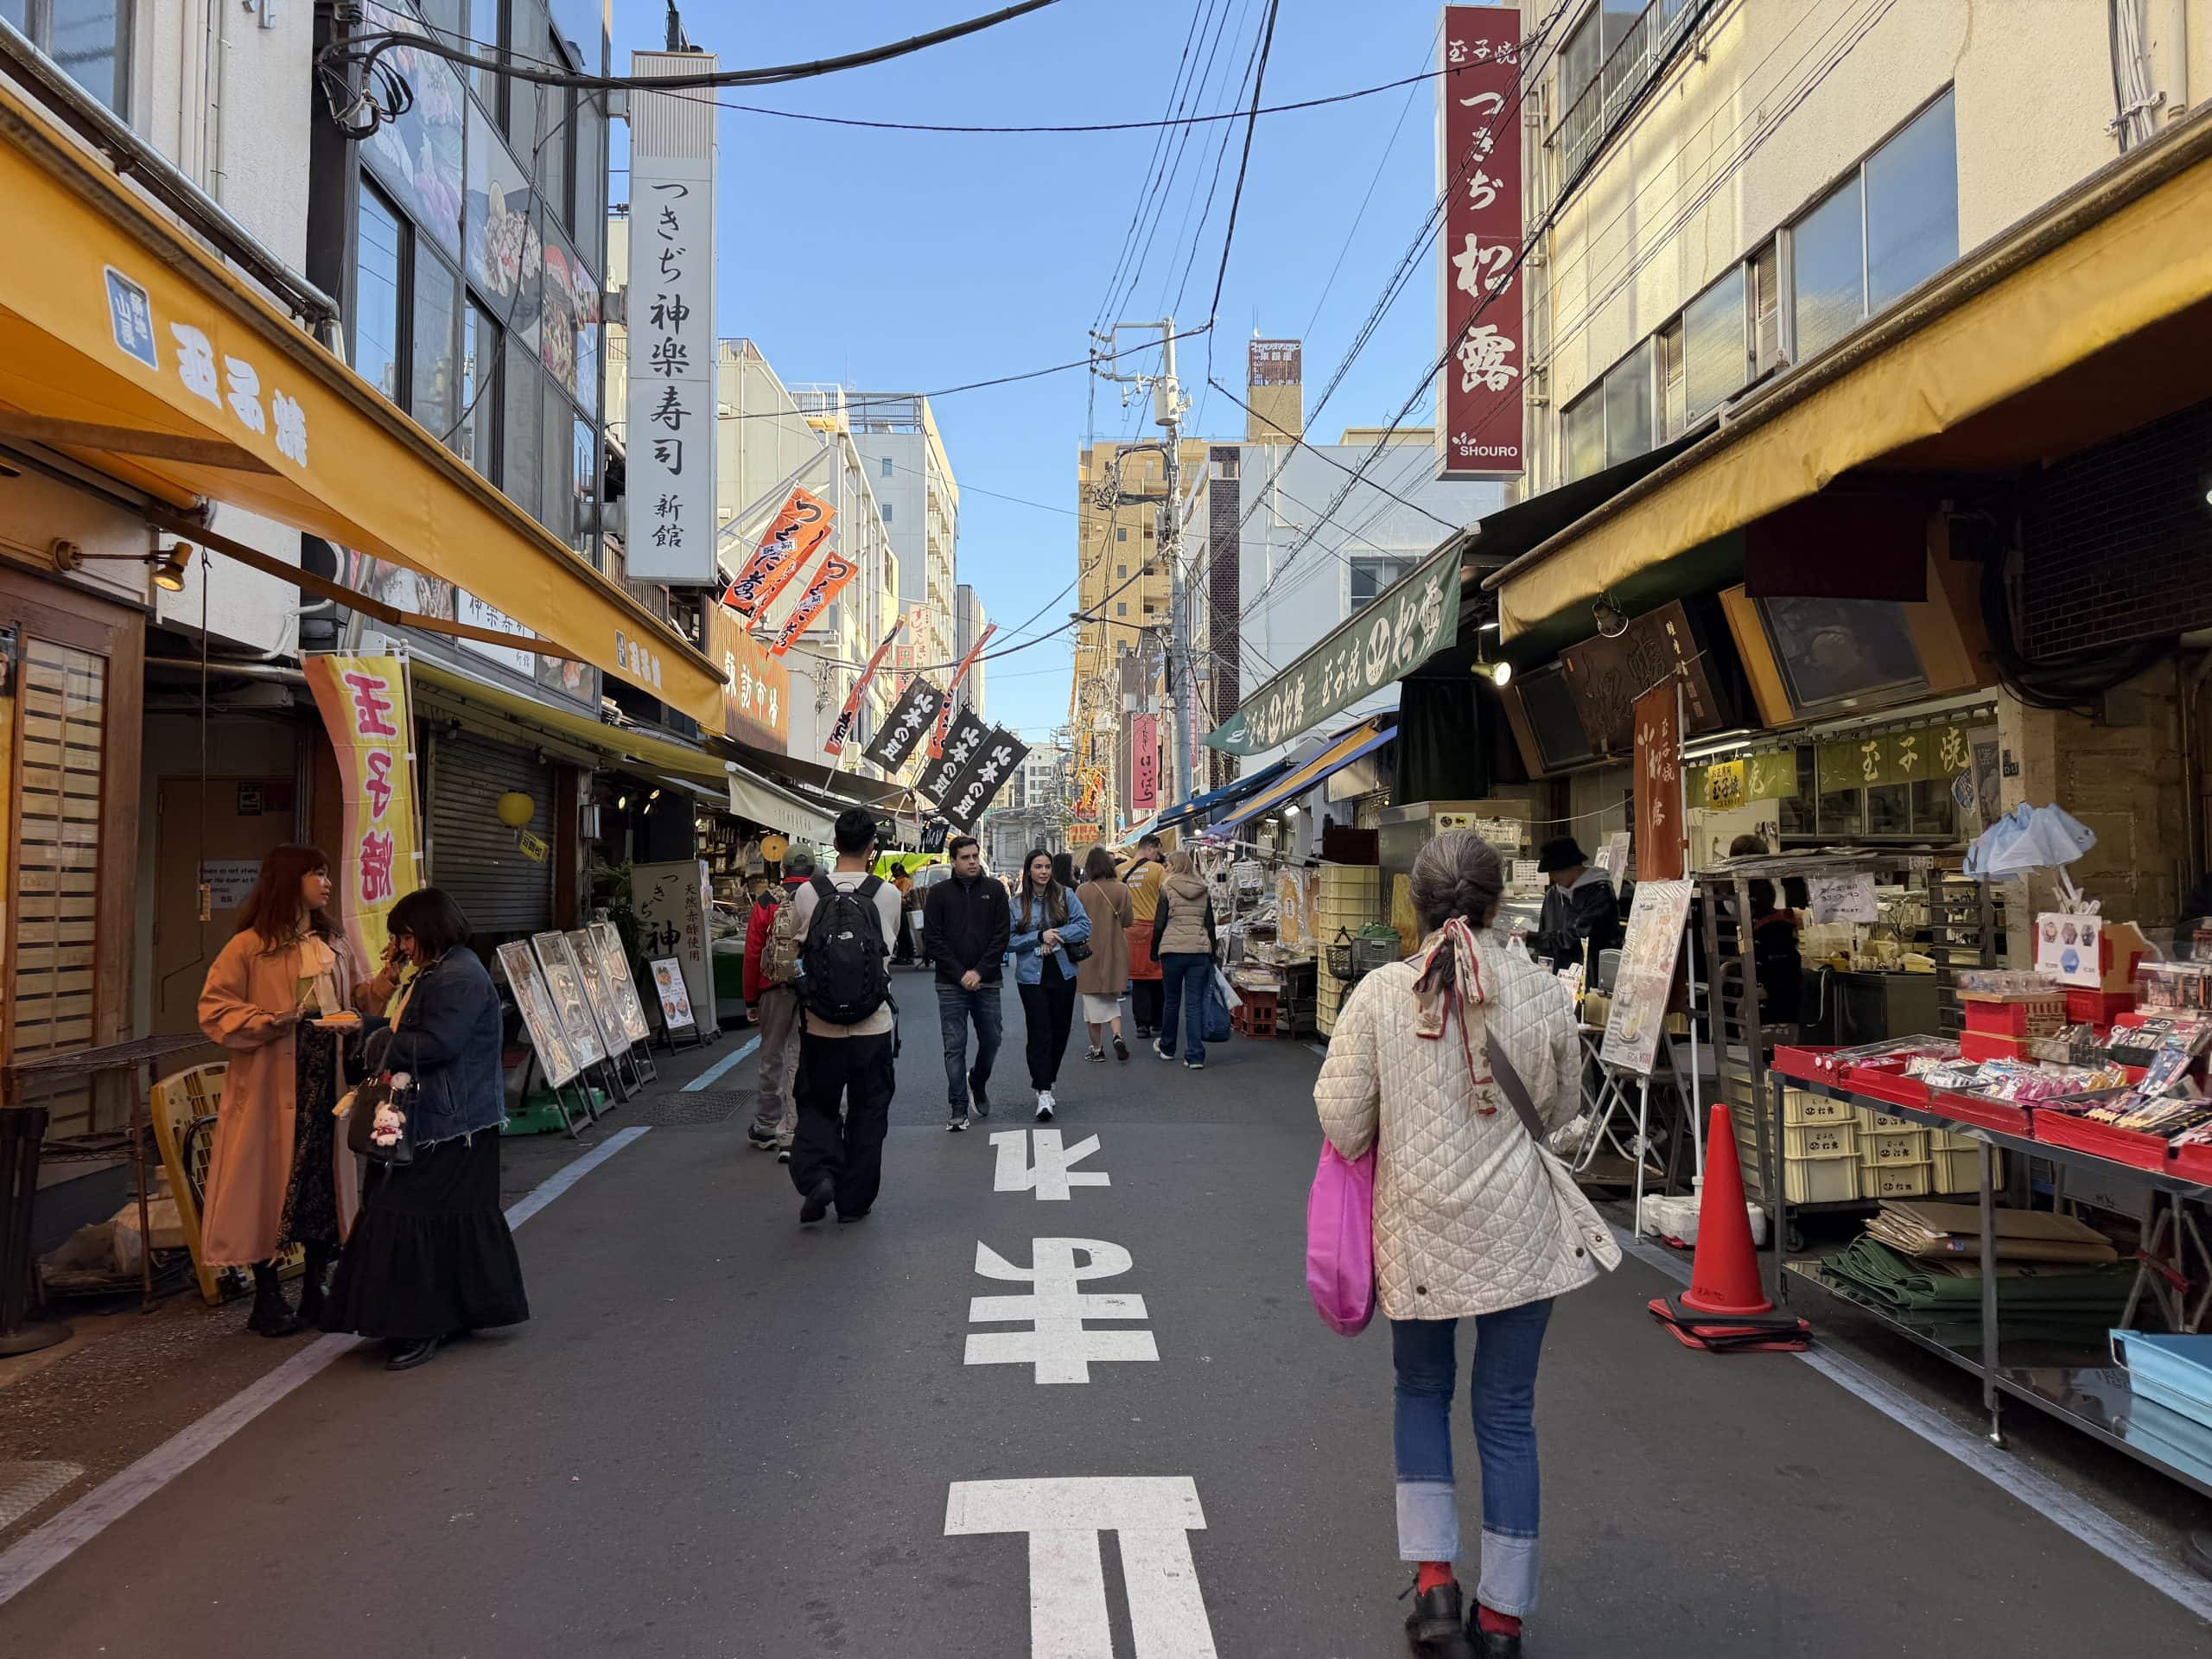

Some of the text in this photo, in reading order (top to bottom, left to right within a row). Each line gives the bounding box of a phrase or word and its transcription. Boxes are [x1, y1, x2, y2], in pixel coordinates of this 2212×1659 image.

[1449, 38, 1518, 66] 玉子焼
[650, 181, 691, 549] つきぢ神楽寿司 新館
[169, 321, 308, 468] 玉子焼
[1459, 443, 1518, 458] SHOURO
[1861, 726, 1971, 782] 玉子焼
[641, 874, 679, 918] つきぢ
[684, 883, 700, 962] 天然赤酢使用
